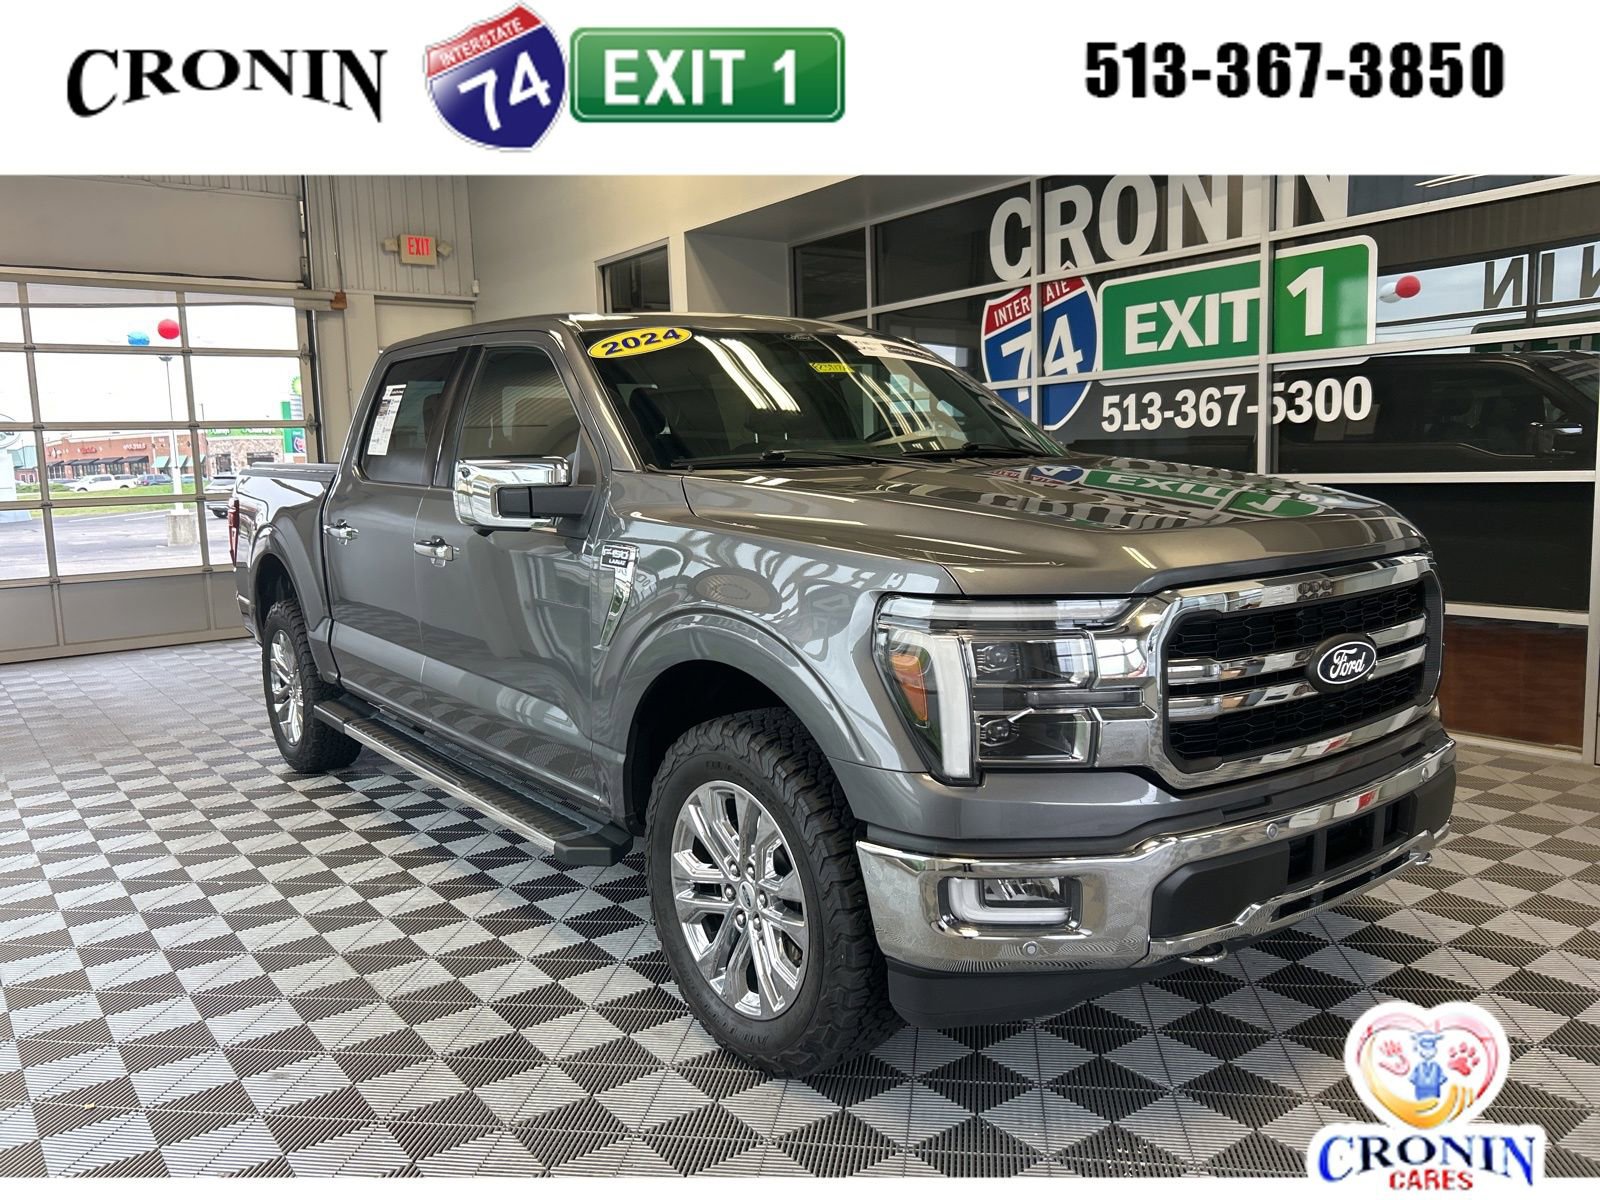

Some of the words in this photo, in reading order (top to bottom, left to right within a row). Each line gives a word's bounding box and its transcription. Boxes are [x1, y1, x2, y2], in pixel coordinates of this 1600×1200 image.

[407, 236, 432, 257] EXIT
[1125, 287, 1261, 355] EXIT
[1286, 266, 1324, 337] 1
[601, 328, 681, 357] 2024
[1000, 314, 1084, 402] 74
[1101, 376, 1372, 433] 513-367-5300
[1329, 647, 1367, 679] Ford
